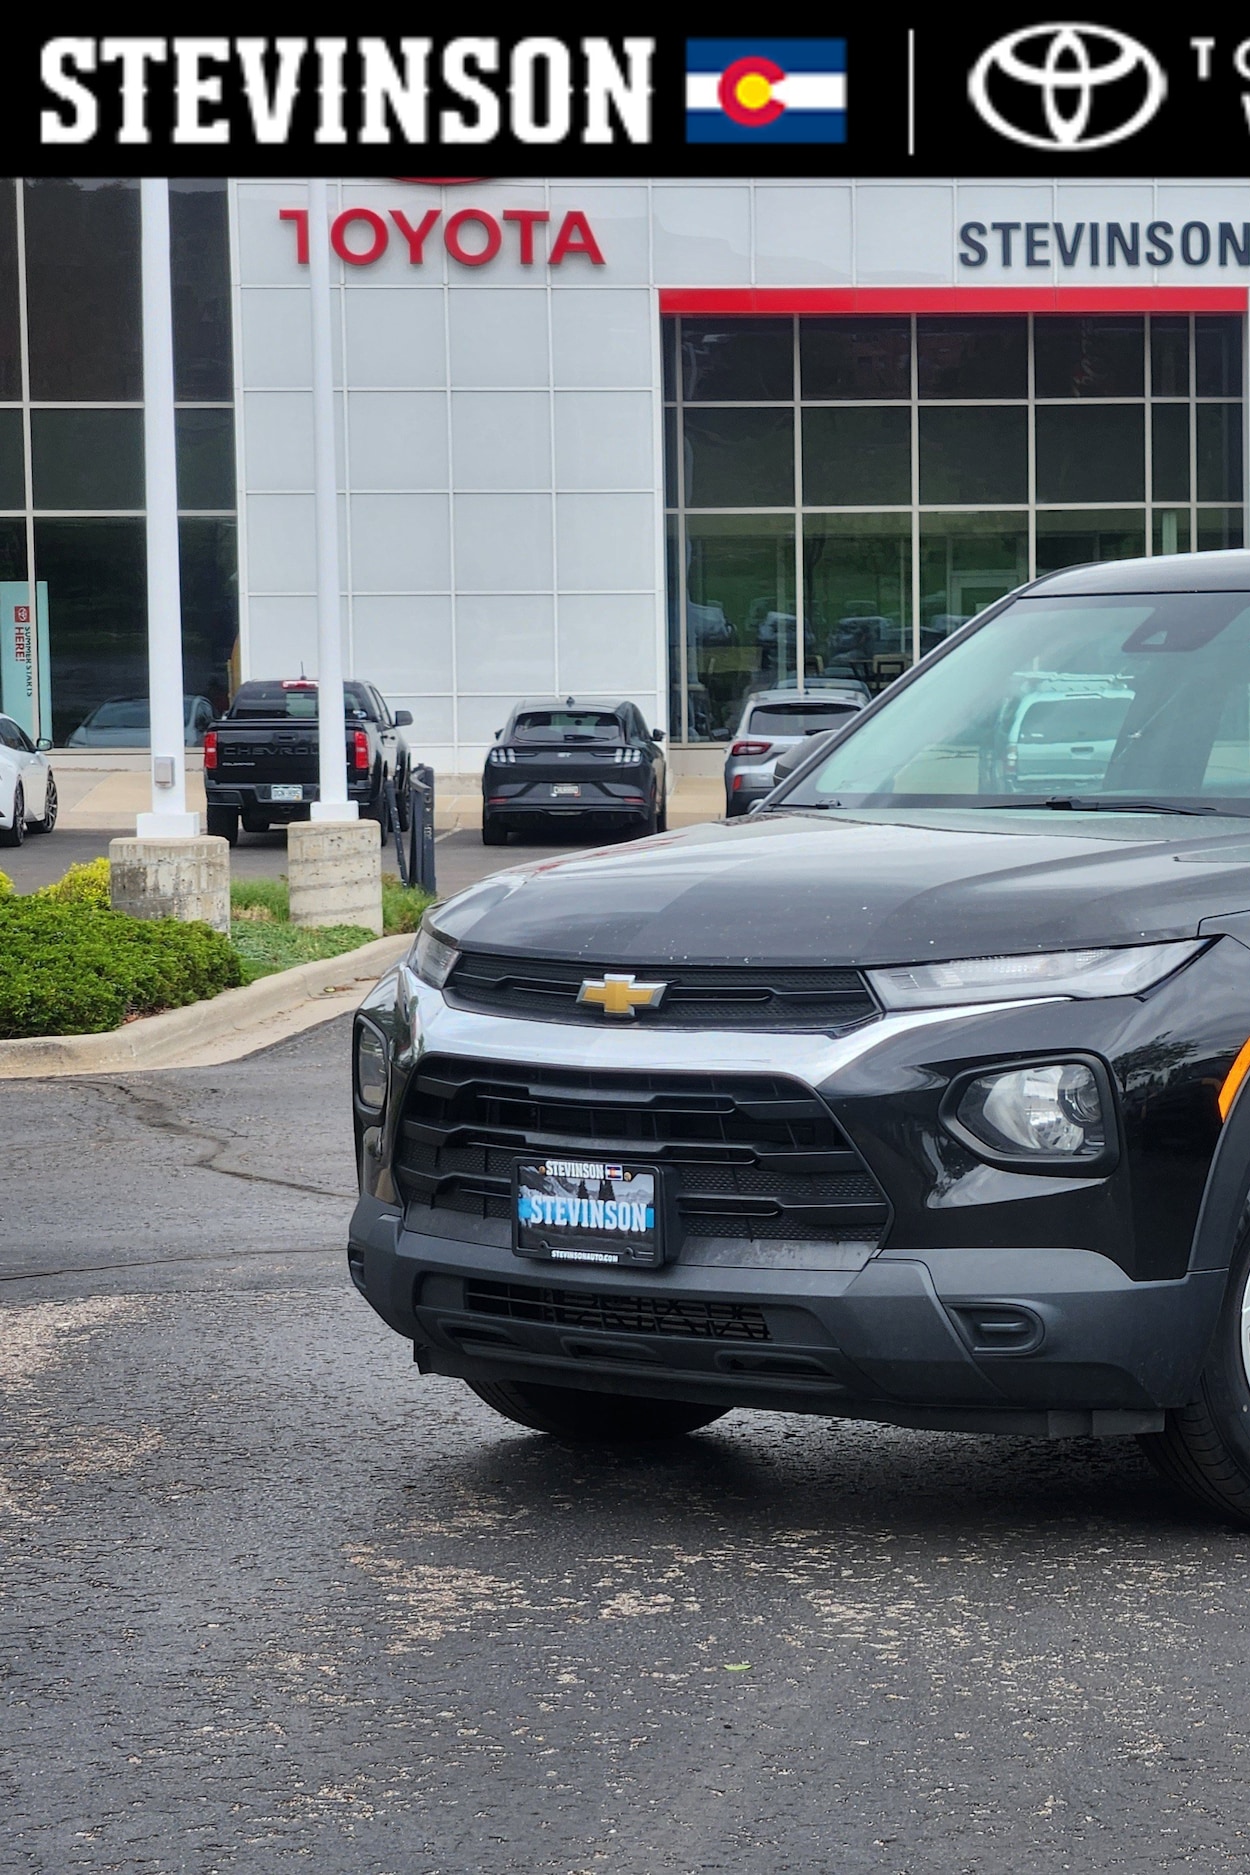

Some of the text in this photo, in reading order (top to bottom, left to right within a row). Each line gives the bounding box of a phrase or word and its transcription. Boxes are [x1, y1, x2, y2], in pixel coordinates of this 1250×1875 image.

[280, 208, 604, 265] TOYOTA
[223, 747, 320, 755] CHEVROL
[545, 1160, 605, 1179] STEVINSON
[531, 1196, 647, 1232] STEVINSON
[551, 1250, 619, 1262] STEVINSONAUTO.COM
